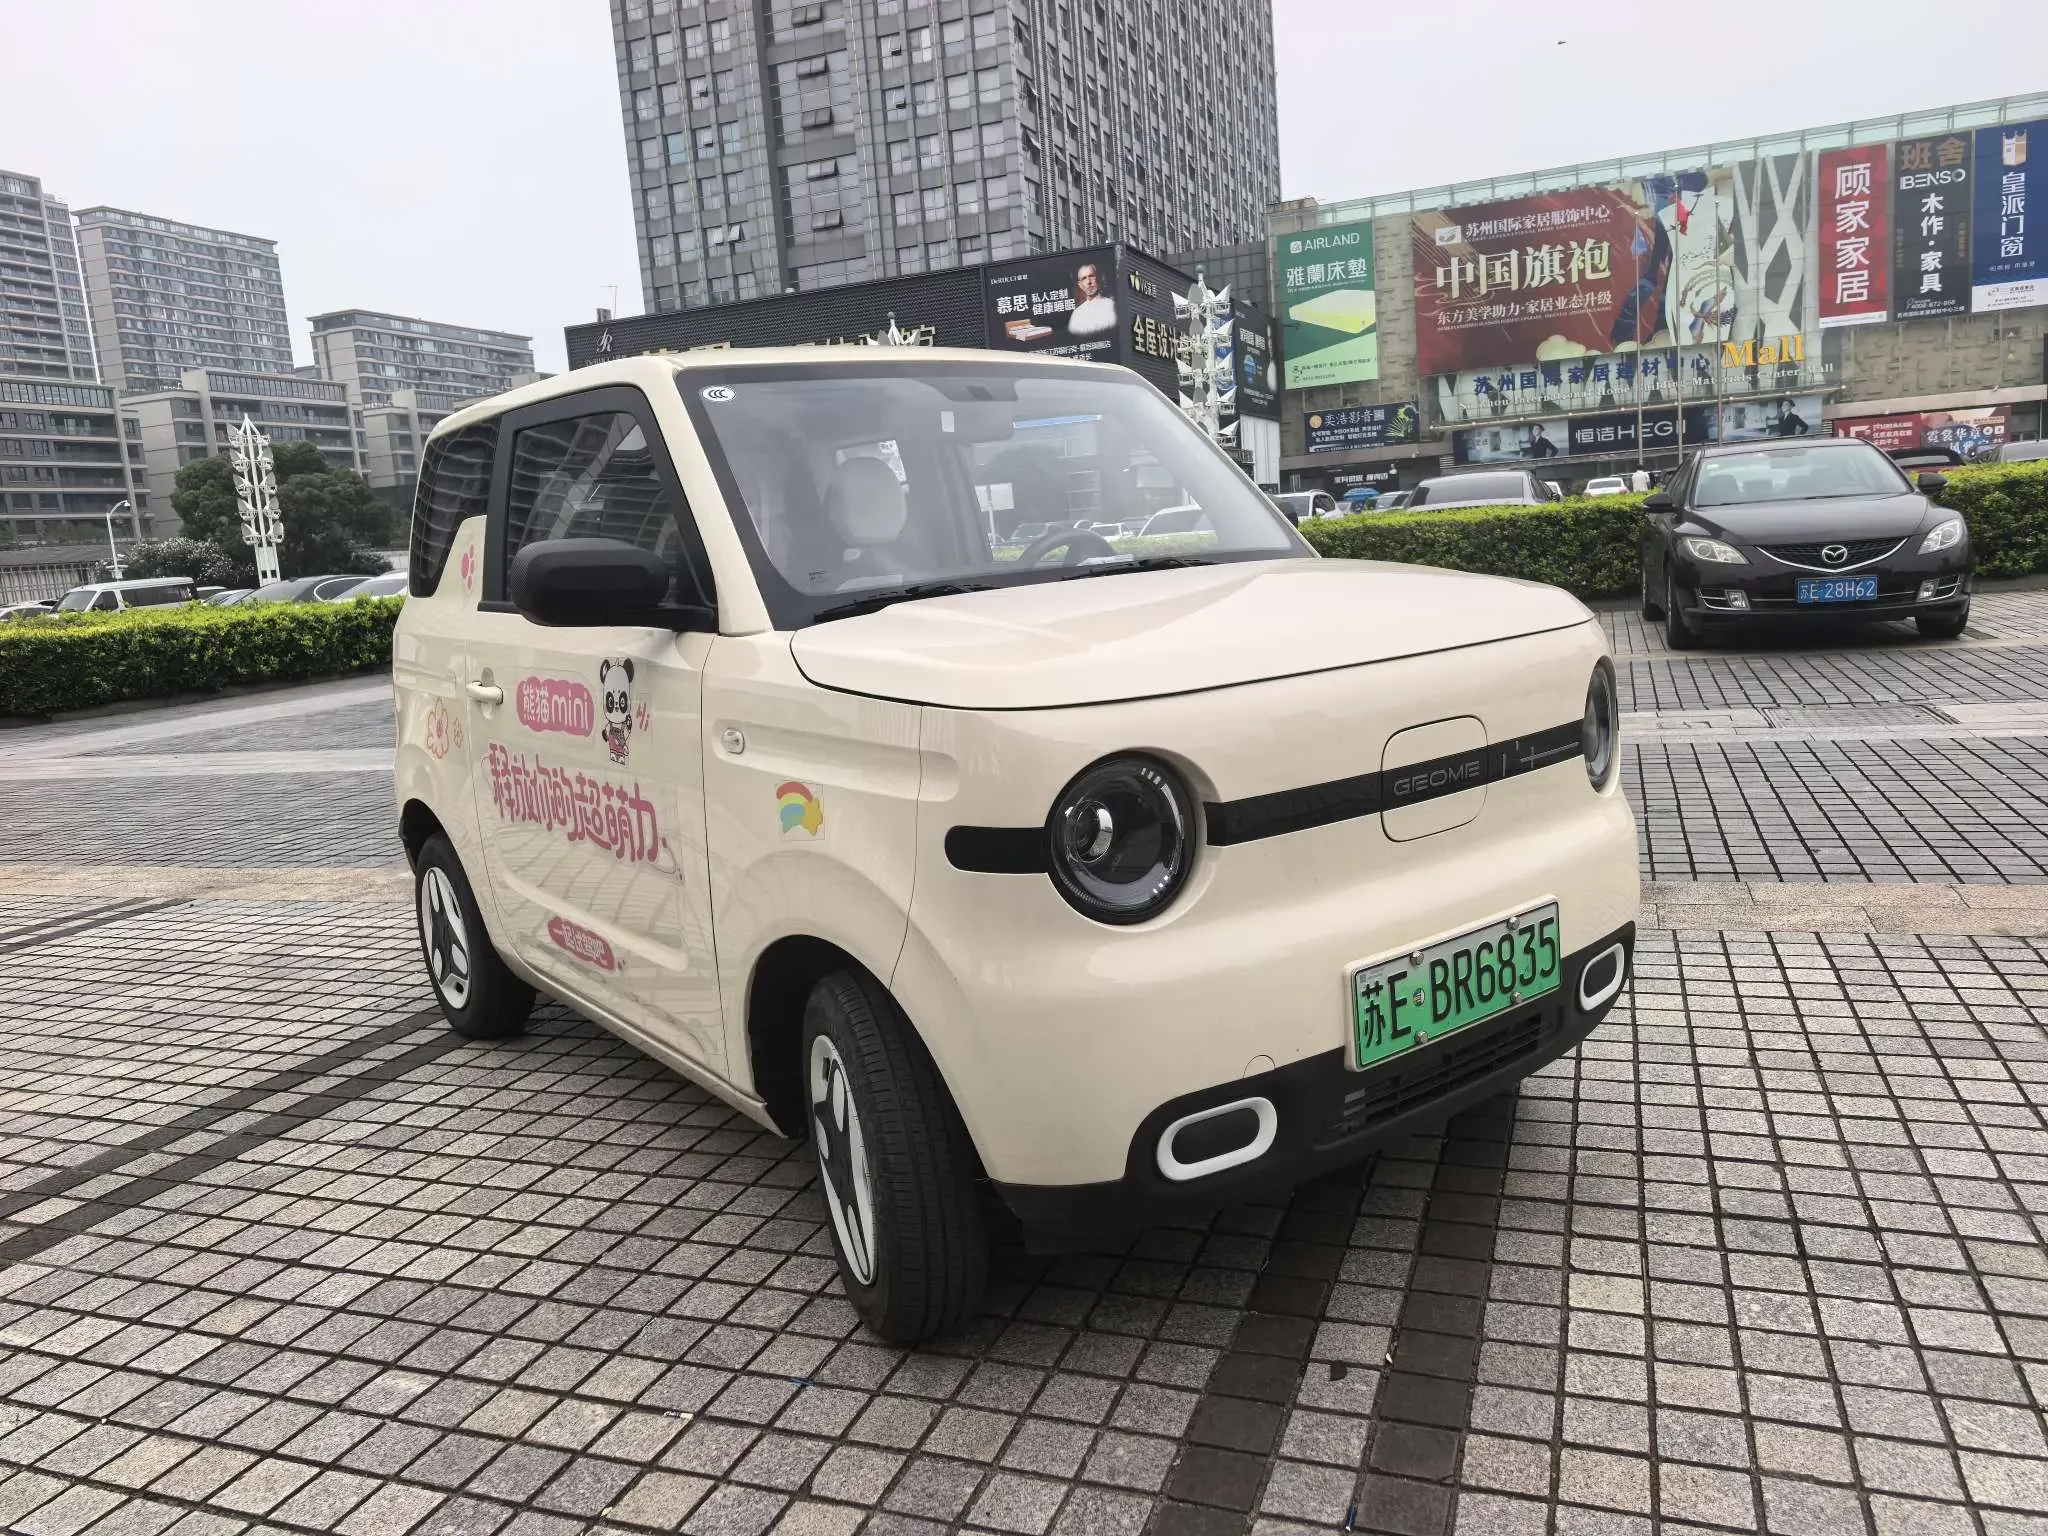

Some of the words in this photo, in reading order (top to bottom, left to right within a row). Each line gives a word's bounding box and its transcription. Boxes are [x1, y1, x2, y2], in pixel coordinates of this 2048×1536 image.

[1902, 137, 1966, 170] 班舍
[1900, 168, 1965, 190] BENSO
[1465, 204, 1611, 236] 苏州国际家居服饰中心
[2001, 171, 2026, 258] 皇派门窗
[1304, 232, 1360, 250] AIRLAND
[1834, 163, 1872, 304] 顾家家居
[1919, 193, 1944, 294] 木作·家具
[1286, 257, 1367, 287] 雅蘭床墊
[1436, 238, 1611, 299] 中国旗袍
[996, 294, 1028, 314] 慕思
[1031, 288, 1068, 303] 私人定制
[1032, 299, 1076, 316] 健康睡眠
[1438, 291, 1612, 325] 东方美学助力·家居业态升级
[1722, 335, 1804, 369] Mall
[1598, 384, 1630, 395] Home
[1806, 363, 1834, 374] Mall
[1393, 760, 1480, 796] GEOME
[489, 743, 658, 862] 释放你的超萌力
